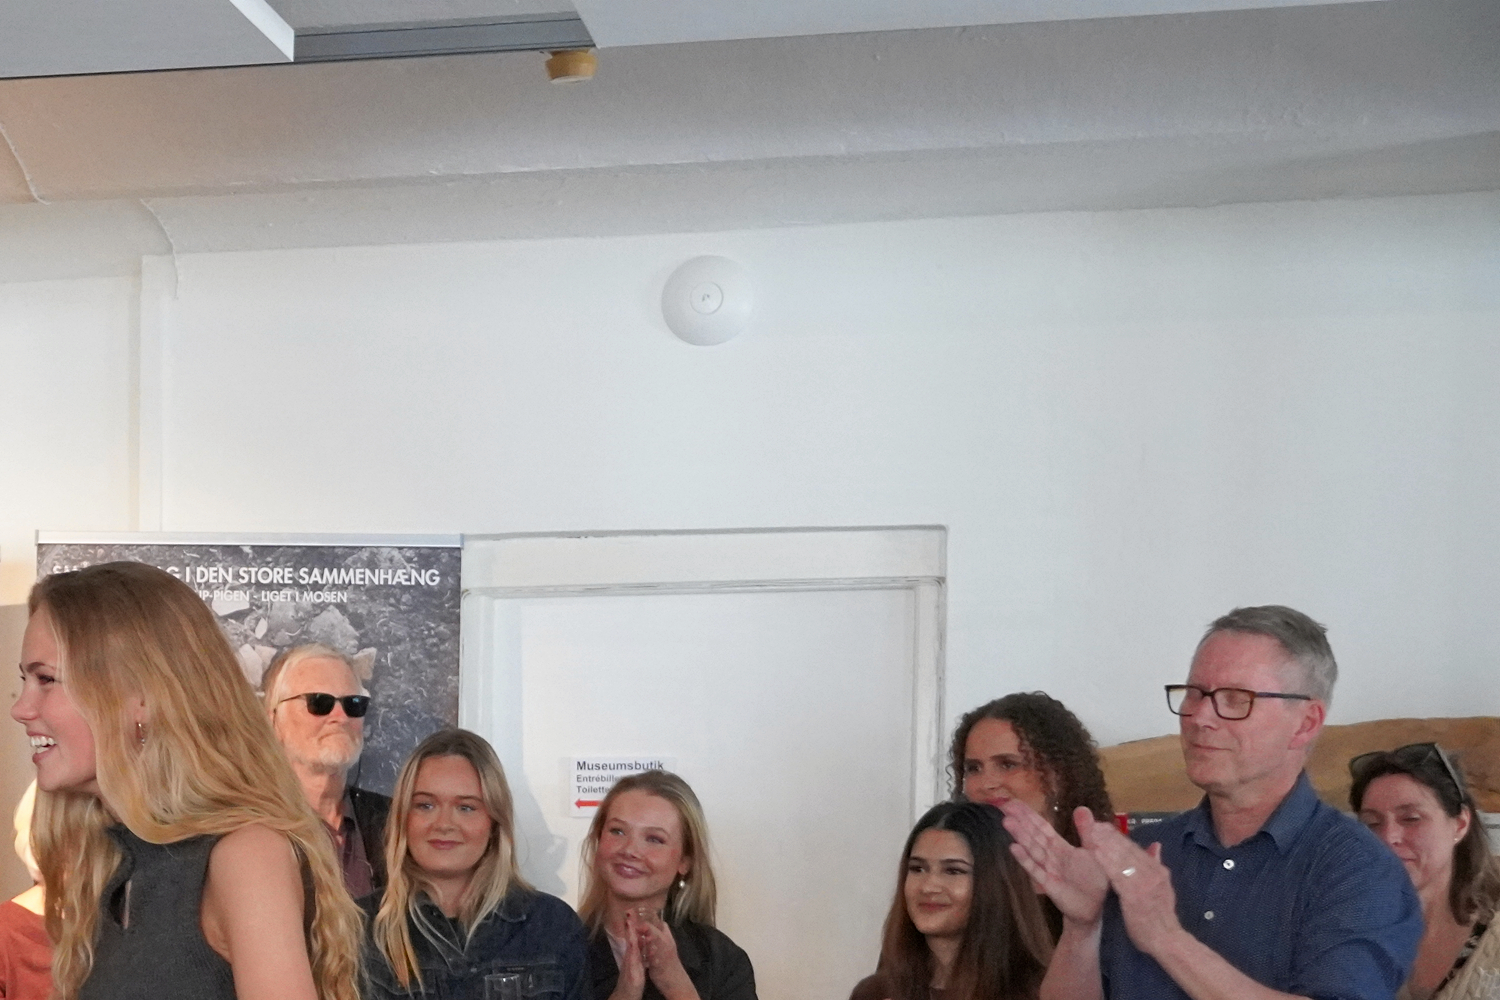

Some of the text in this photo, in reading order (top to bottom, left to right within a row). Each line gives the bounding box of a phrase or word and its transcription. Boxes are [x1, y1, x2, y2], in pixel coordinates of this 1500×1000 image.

[185, 566, 190, 583] I
[196, 566, 233, 583] DEN
[238, 567, 293, 584] STORE
[298, 567, 441, 586] SAMMENHÆNG
[261, 590, 292, 602] LIGET
[302, 591, 348, 603] MOSEN
[576, 760, 664, 771] Museumsbutik
[576, 774, 621, 783] Entrébille
[576, 785, 610, 794] Toilette
